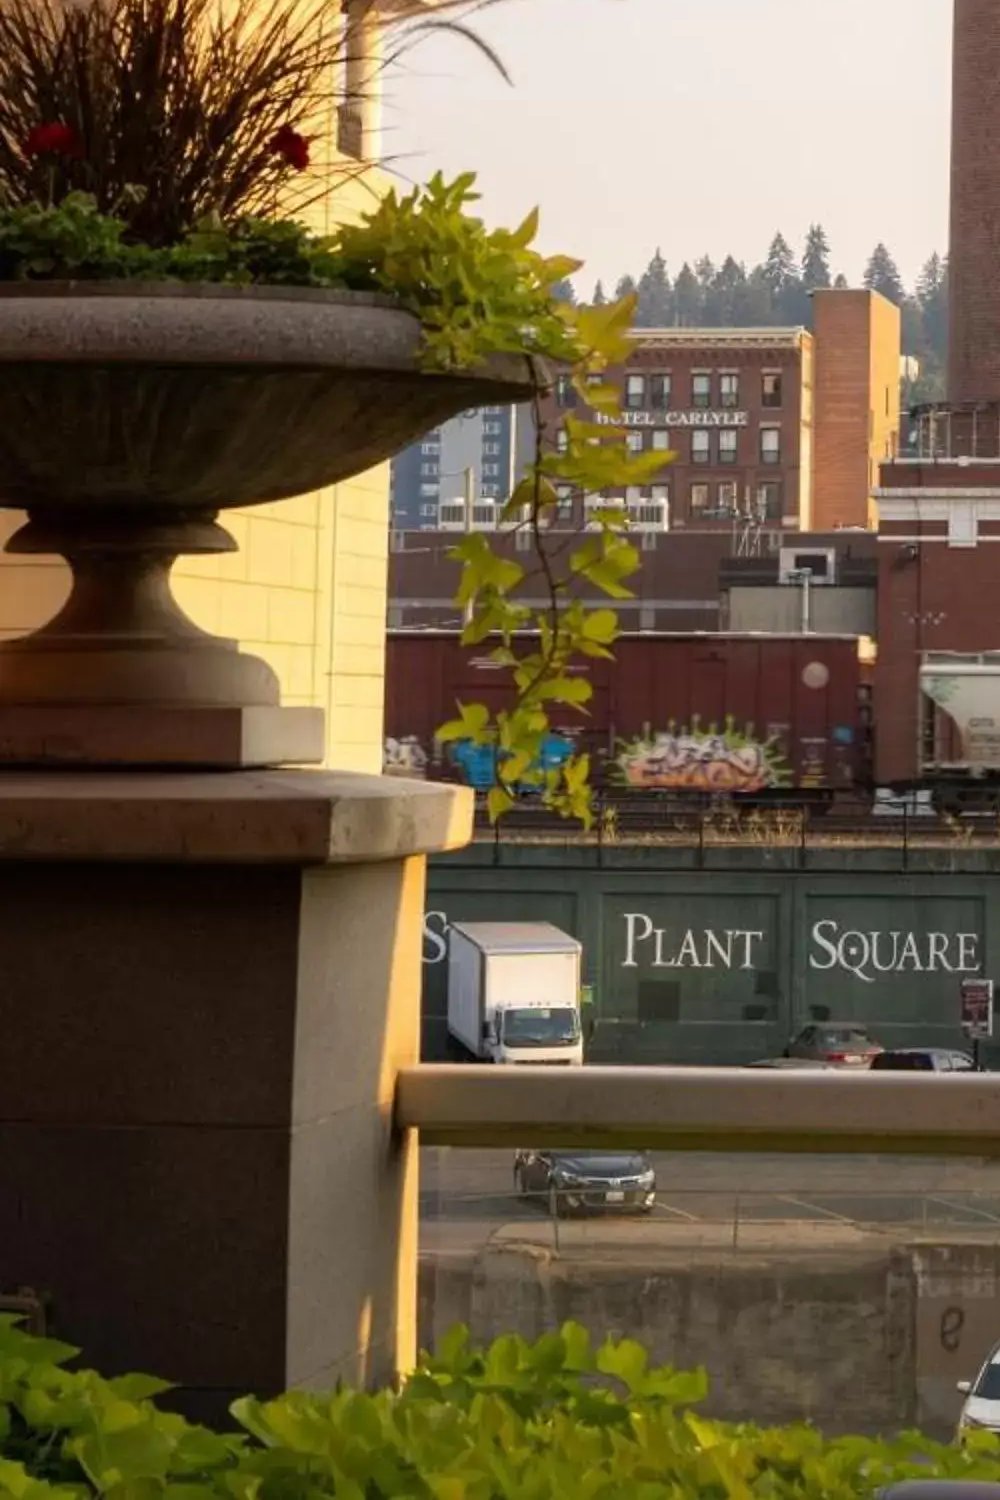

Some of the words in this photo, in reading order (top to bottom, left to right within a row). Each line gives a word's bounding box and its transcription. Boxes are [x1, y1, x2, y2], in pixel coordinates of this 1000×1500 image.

[665, 411, 748, 425] CARLYLE
[621, 913, 763, 969] PLANT
[809, 919, 981, 982] SQUARE
